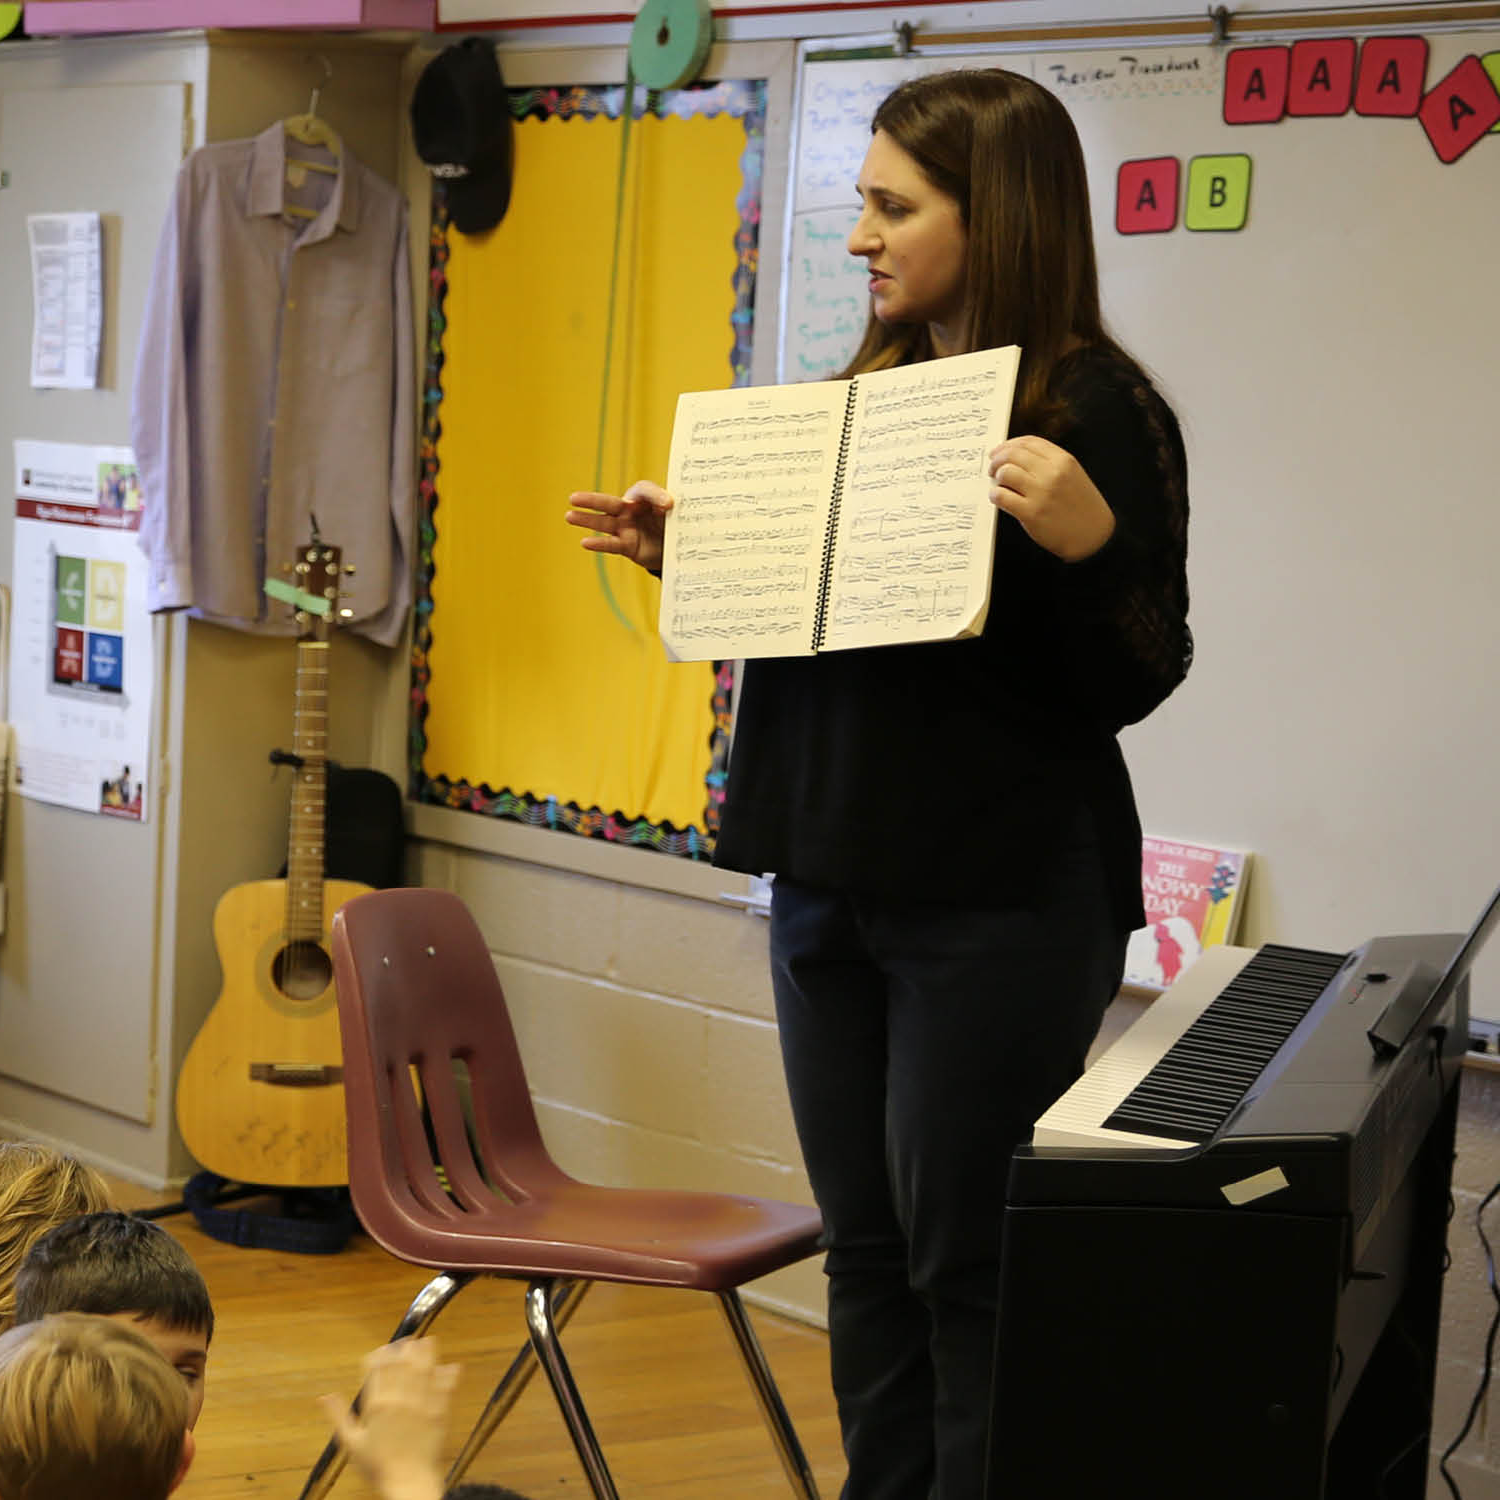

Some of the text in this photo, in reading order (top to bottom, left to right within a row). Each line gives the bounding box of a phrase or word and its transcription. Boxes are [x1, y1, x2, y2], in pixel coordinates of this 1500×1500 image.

[1049, 64, 1116, 85] Review
[1243, 57, 1476, 131] A A A A
[1135, 176, 1228, 211] A B
[1157, 861, 1188, 877] THE
[1142, 875, 1202, 901] NOWY
[1145, 893, 1183, 917] DAY
